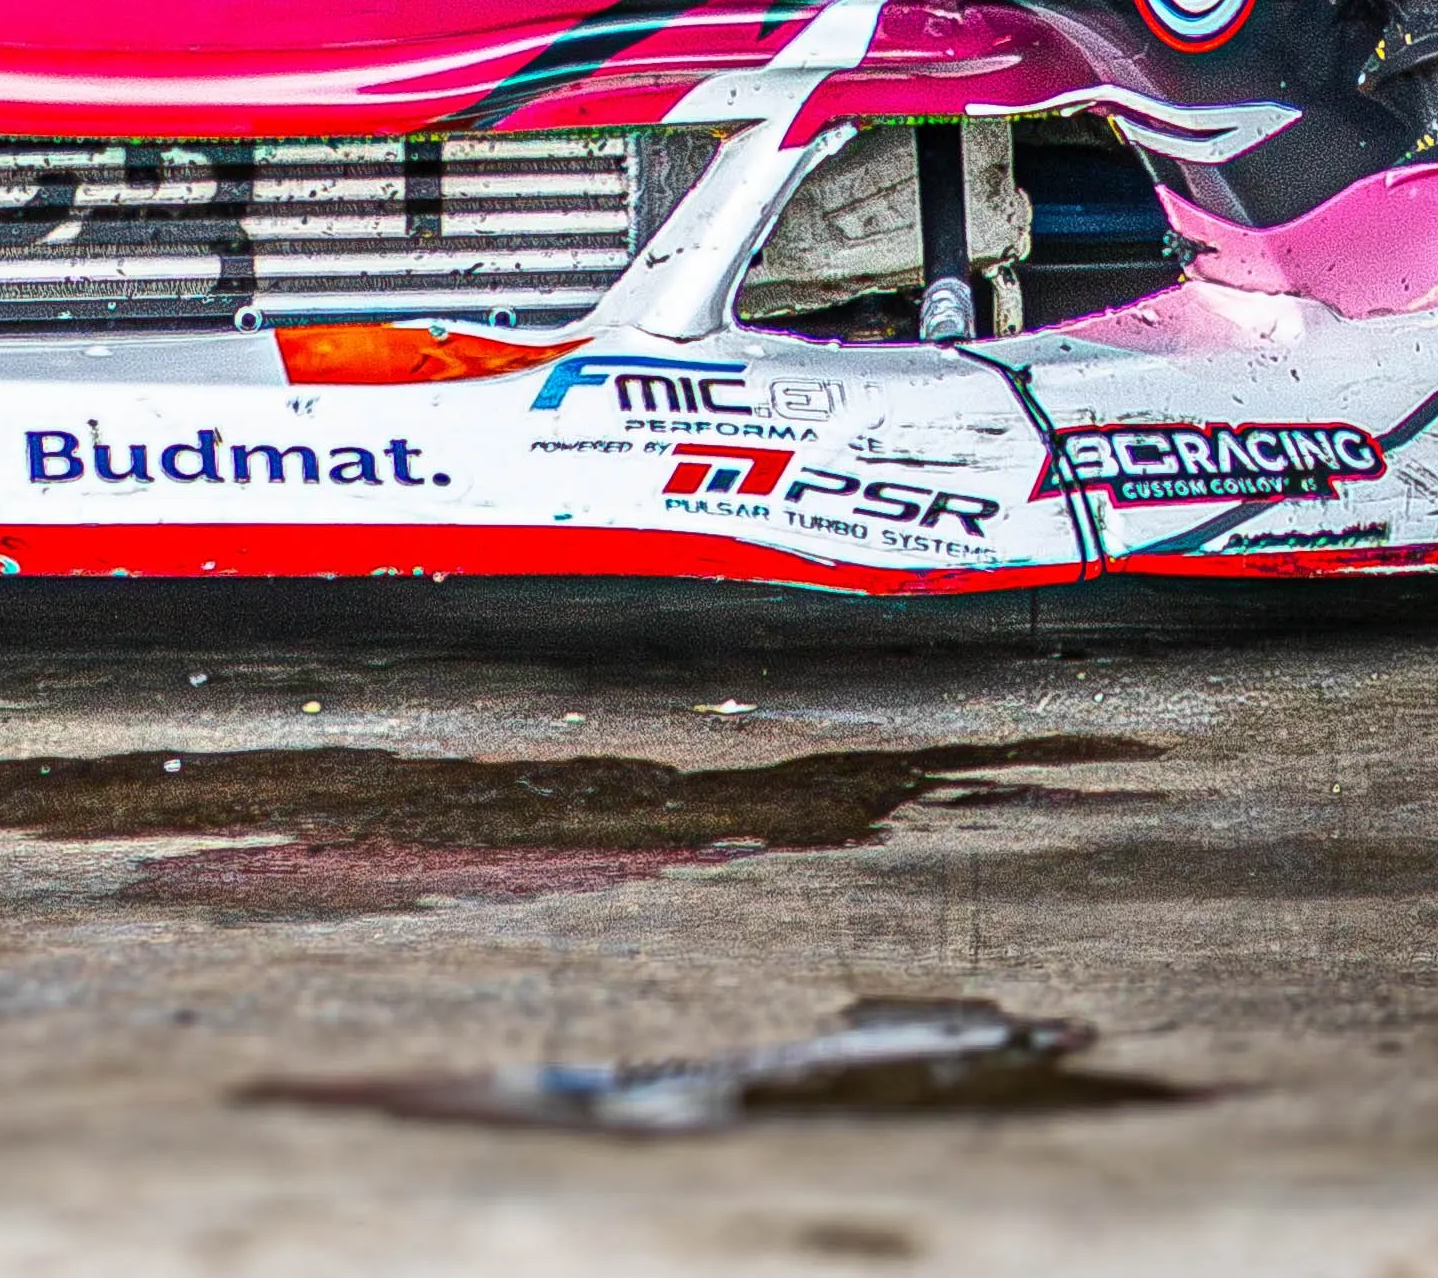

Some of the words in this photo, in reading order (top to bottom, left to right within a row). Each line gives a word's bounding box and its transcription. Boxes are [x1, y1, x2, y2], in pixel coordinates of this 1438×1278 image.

[25, 427, 453, 487] Budmat.
[624, 418, 886, 456] PERFORMACE
[1173, 430, 1375, 475] RACING
[1122, 479, 1207, 500] CUSTOM
[664, 497, 771, 523] PULSAR
[783, 509, 868, 541] TURBO
[881, 528, 1000, 566] SYSTEMS
